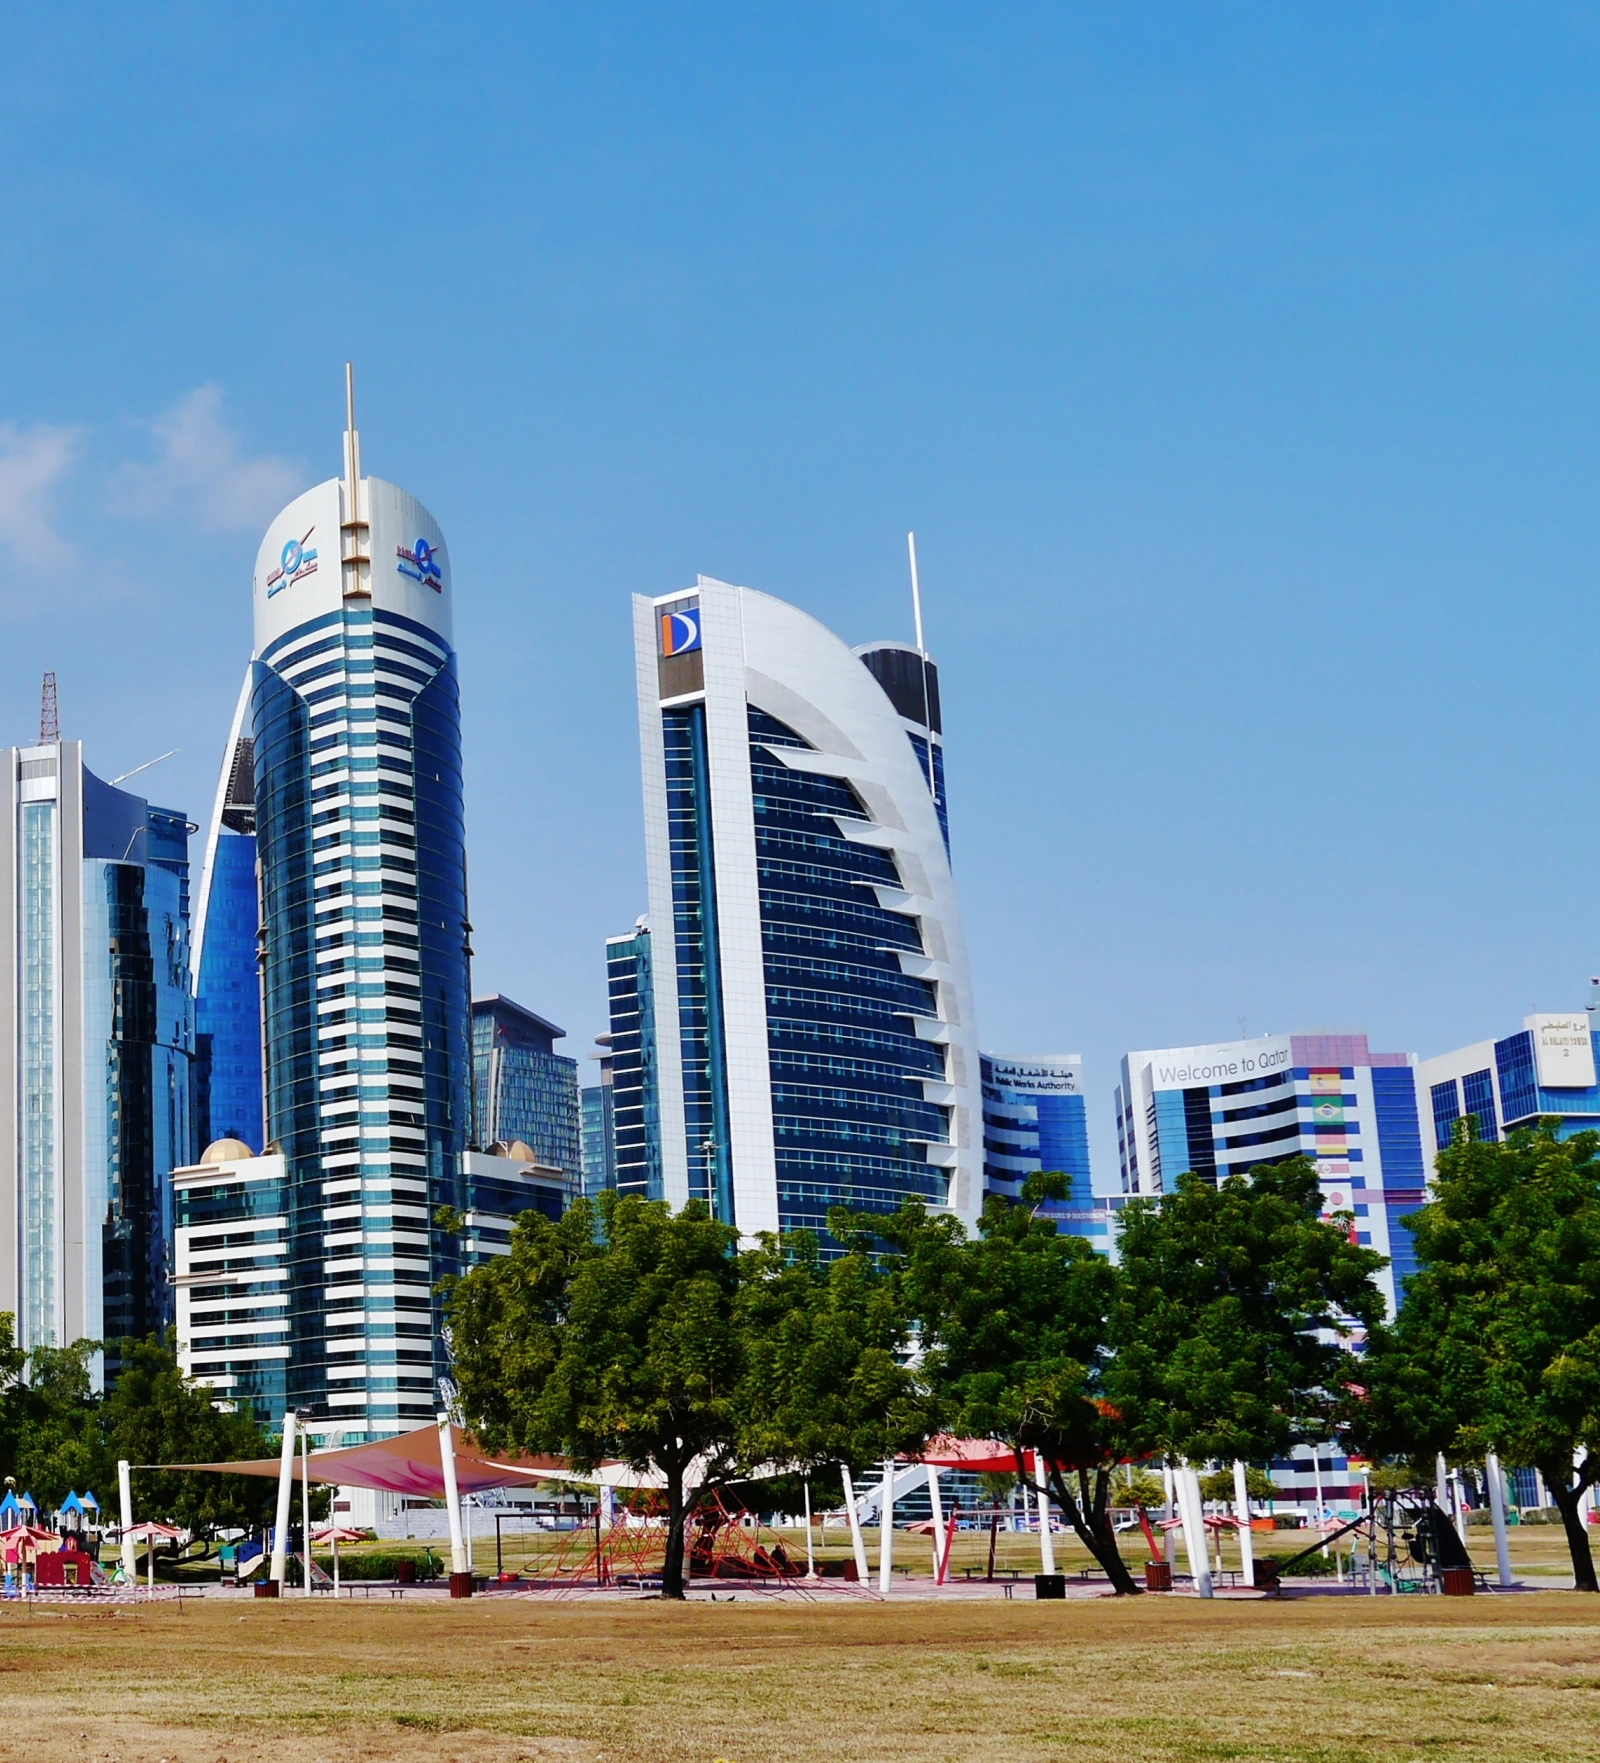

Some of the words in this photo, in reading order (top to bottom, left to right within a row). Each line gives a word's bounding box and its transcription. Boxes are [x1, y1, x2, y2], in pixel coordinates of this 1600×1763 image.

[1563, 1048, 1570, 1057] 2
[1159, 1062, 1238, 1083] Welcome
[1241, 1057, 1255, 1073] to
[1258, 1049, 1289, 1069] Qatar
[1013, 1078, 1036, 1089] Works
[1036, 1080, 1076, 1092] Authority
